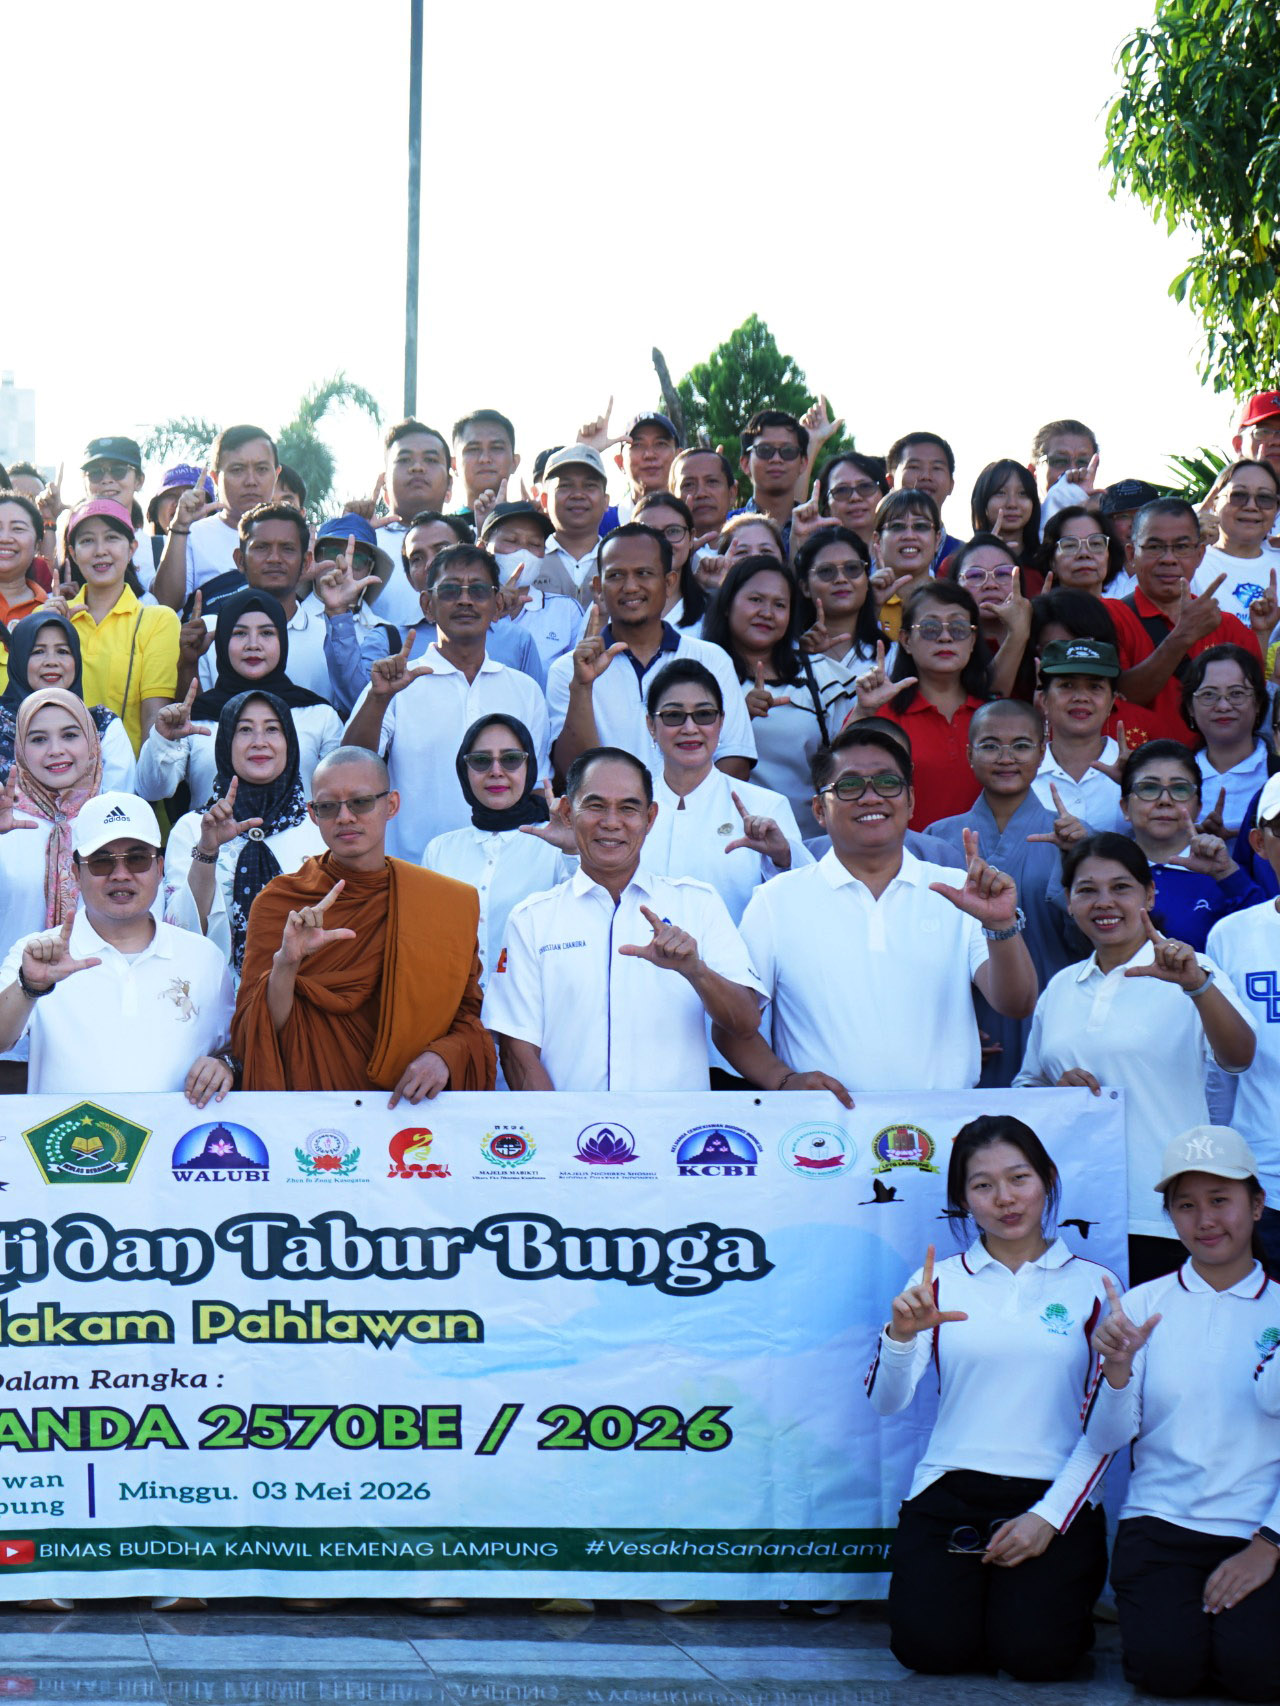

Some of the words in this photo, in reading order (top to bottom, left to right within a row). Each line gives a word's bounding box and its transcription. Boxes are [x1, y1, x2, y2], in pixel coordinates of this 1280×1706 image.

[104, 816, 131, 824] adidas
[676, 1165, 758, 1177] KCBI
[898, 1161, 930, 1169] LAMPUNG
[172, 1171, 270, 1182] WALUBI
[57, 1215, 211, 1284] dan
[220, 1213, 465, 1279] Tabur
[478, 1214, 767, 1294] Bunga
[195, 1300, 482, 1347] Pahlawan
[91, 1367, 208, 1393] Rangka
[199, 1403, 463, 1452] 2570BE
[475, 1402, 525, 1456] /
[536, 1405, 734, 1453] 2026
[119, 1480, 239, 1503] Minggu.
[252, 1481, 287, 1501] 03
[295, 1480, 352, 1501] Mei
[359, 1481, 431, 1501] 2026
[39, 1543, 111, 1558] BIMAS
[120, 1541, 217, 1557] BUDDHA
[225, 1540, 312, 1558] KANWIL
[320, 1541, 435, 1557] KEMENAG
[442, 1541, 559, 1557] LAMPUNG
